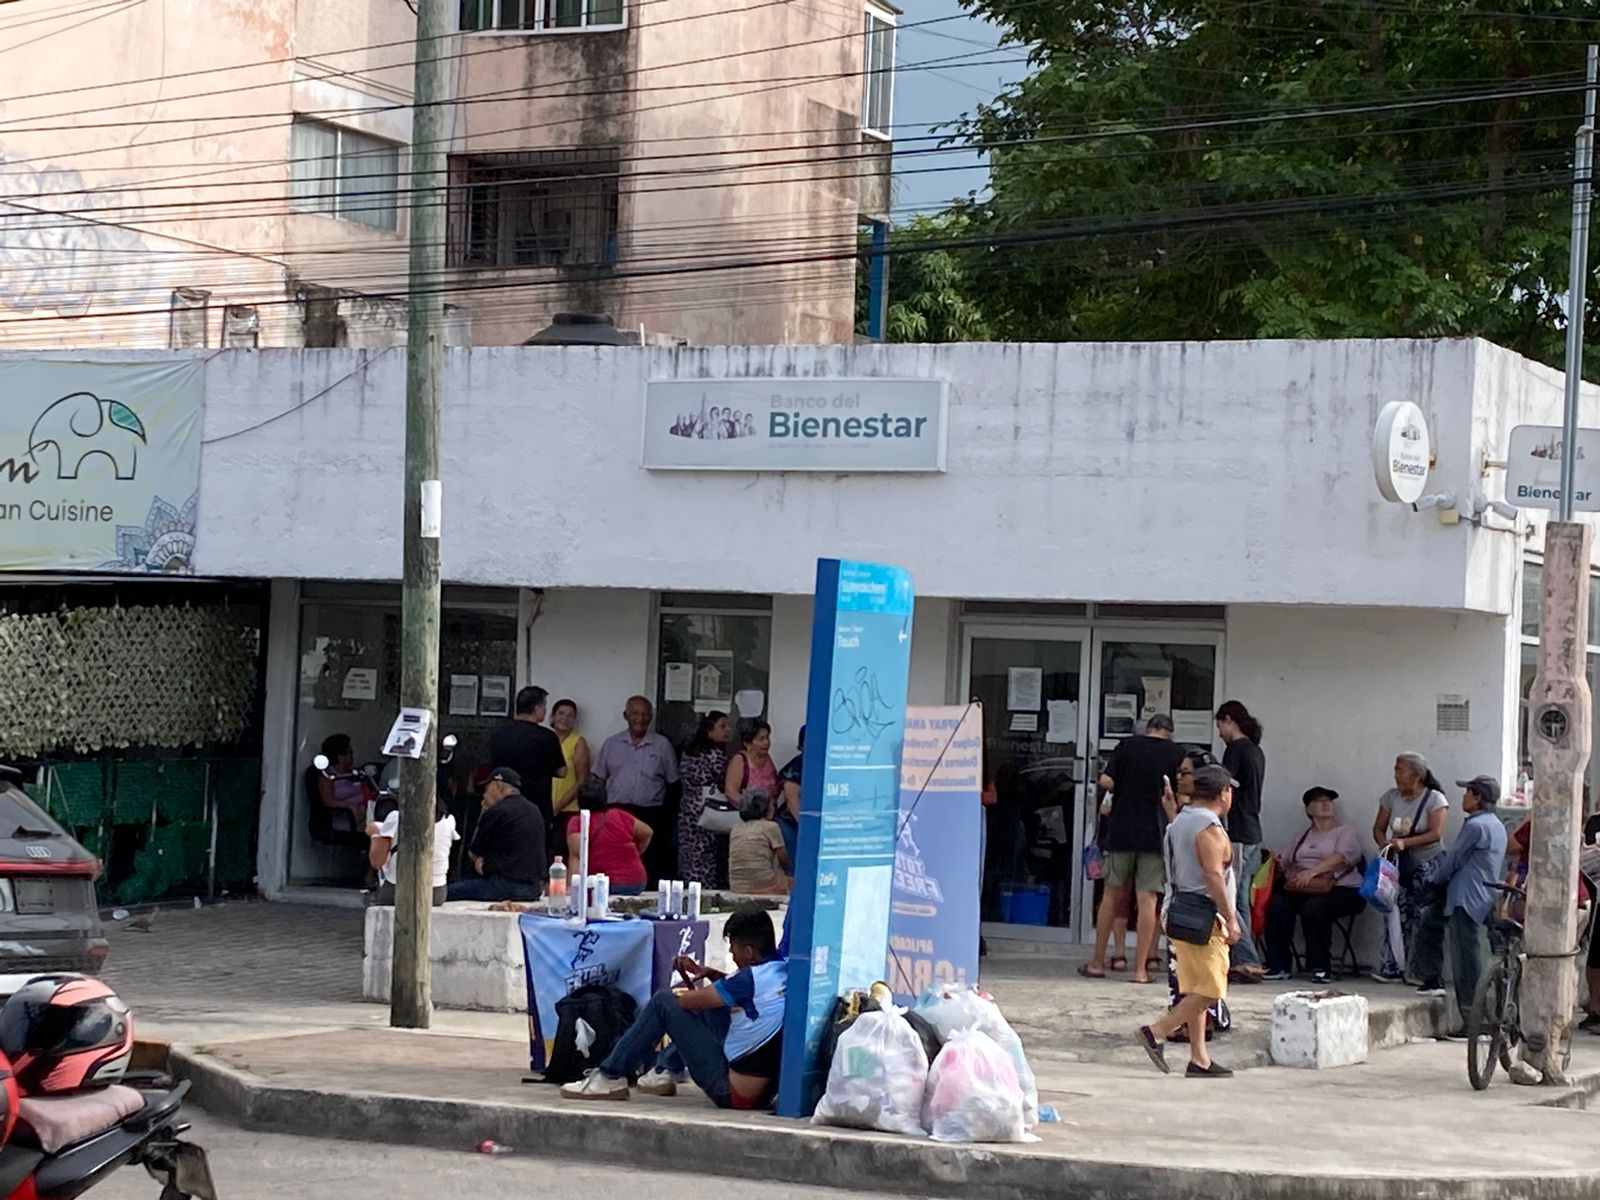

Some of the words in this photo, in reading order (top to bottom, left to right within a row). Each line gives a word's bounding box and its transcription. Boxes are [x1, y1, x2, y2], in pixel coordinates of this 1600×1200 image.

[769, 394, 827, 409] Banco
[832, 393, 860, 409] del
[768, 411, 928, 438] Bienestar
[1392, 459, 1426, 476] Bienestar
[1517, 484, 1592, 501] Bienear
[29, 499, 113, 522] Cuisine
